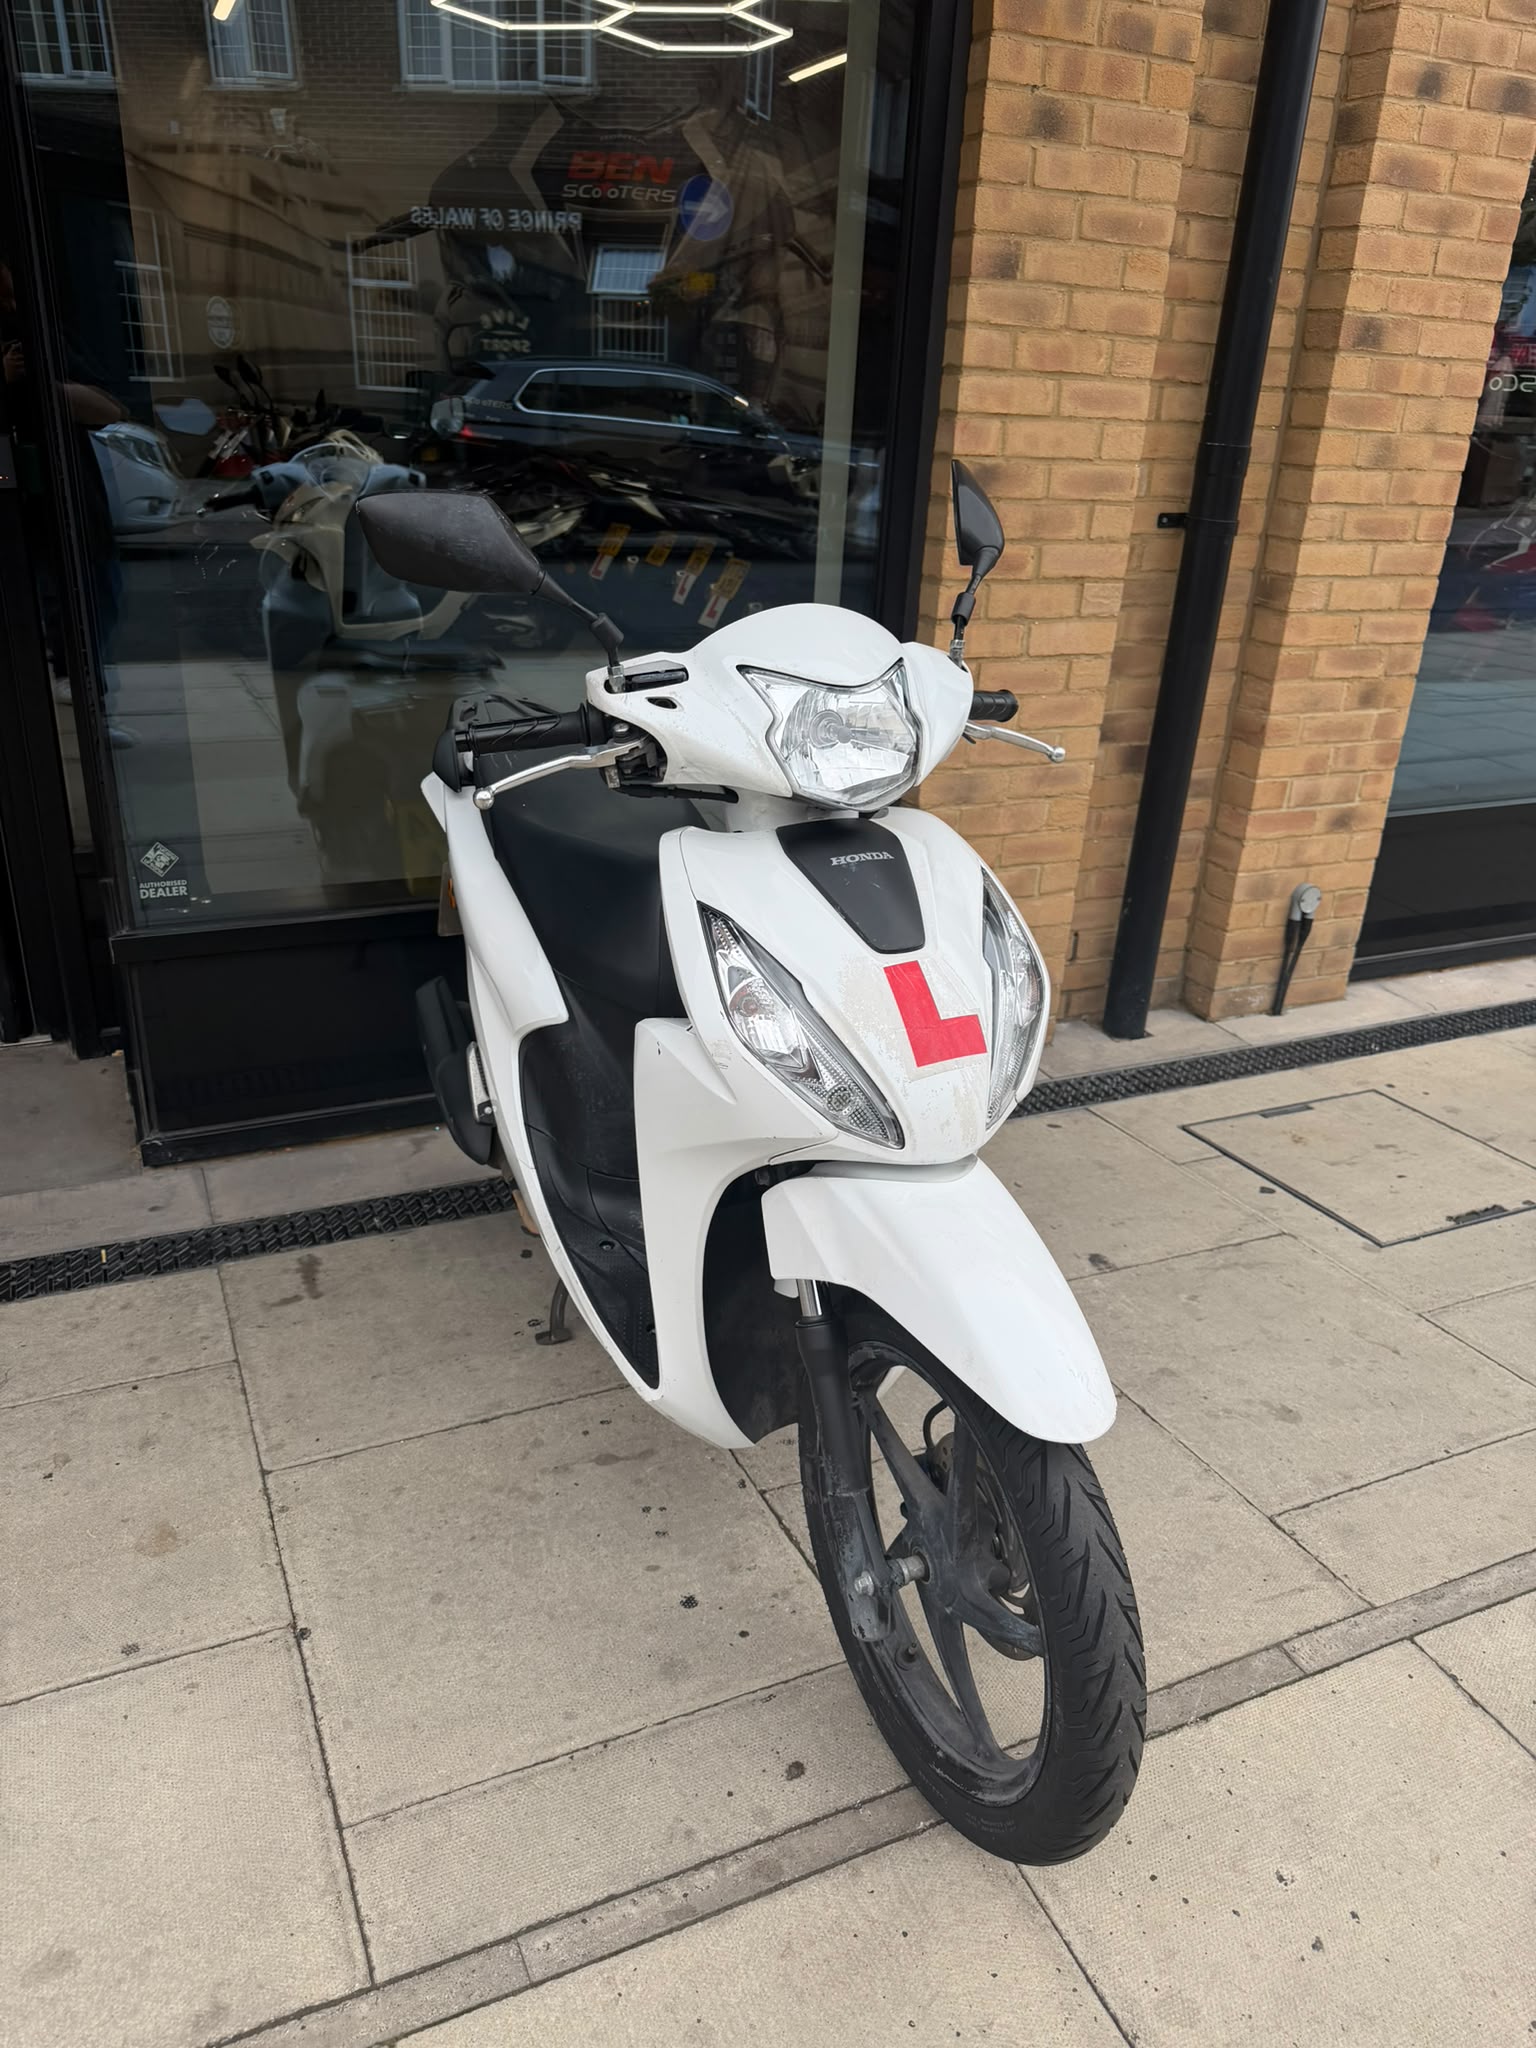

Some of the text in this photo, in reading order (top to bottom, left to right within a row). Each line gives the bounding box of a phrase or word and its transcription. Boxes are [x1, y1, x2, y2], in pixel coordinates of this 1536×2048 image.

[568, 152, 675, 184] BEN
[830, 851, 894, 866] HONDA
[139, 880, 188, 889] AUTHORISED
[139, 886, 188, 899] DEALER
[883, 960, 987, 1067] L
